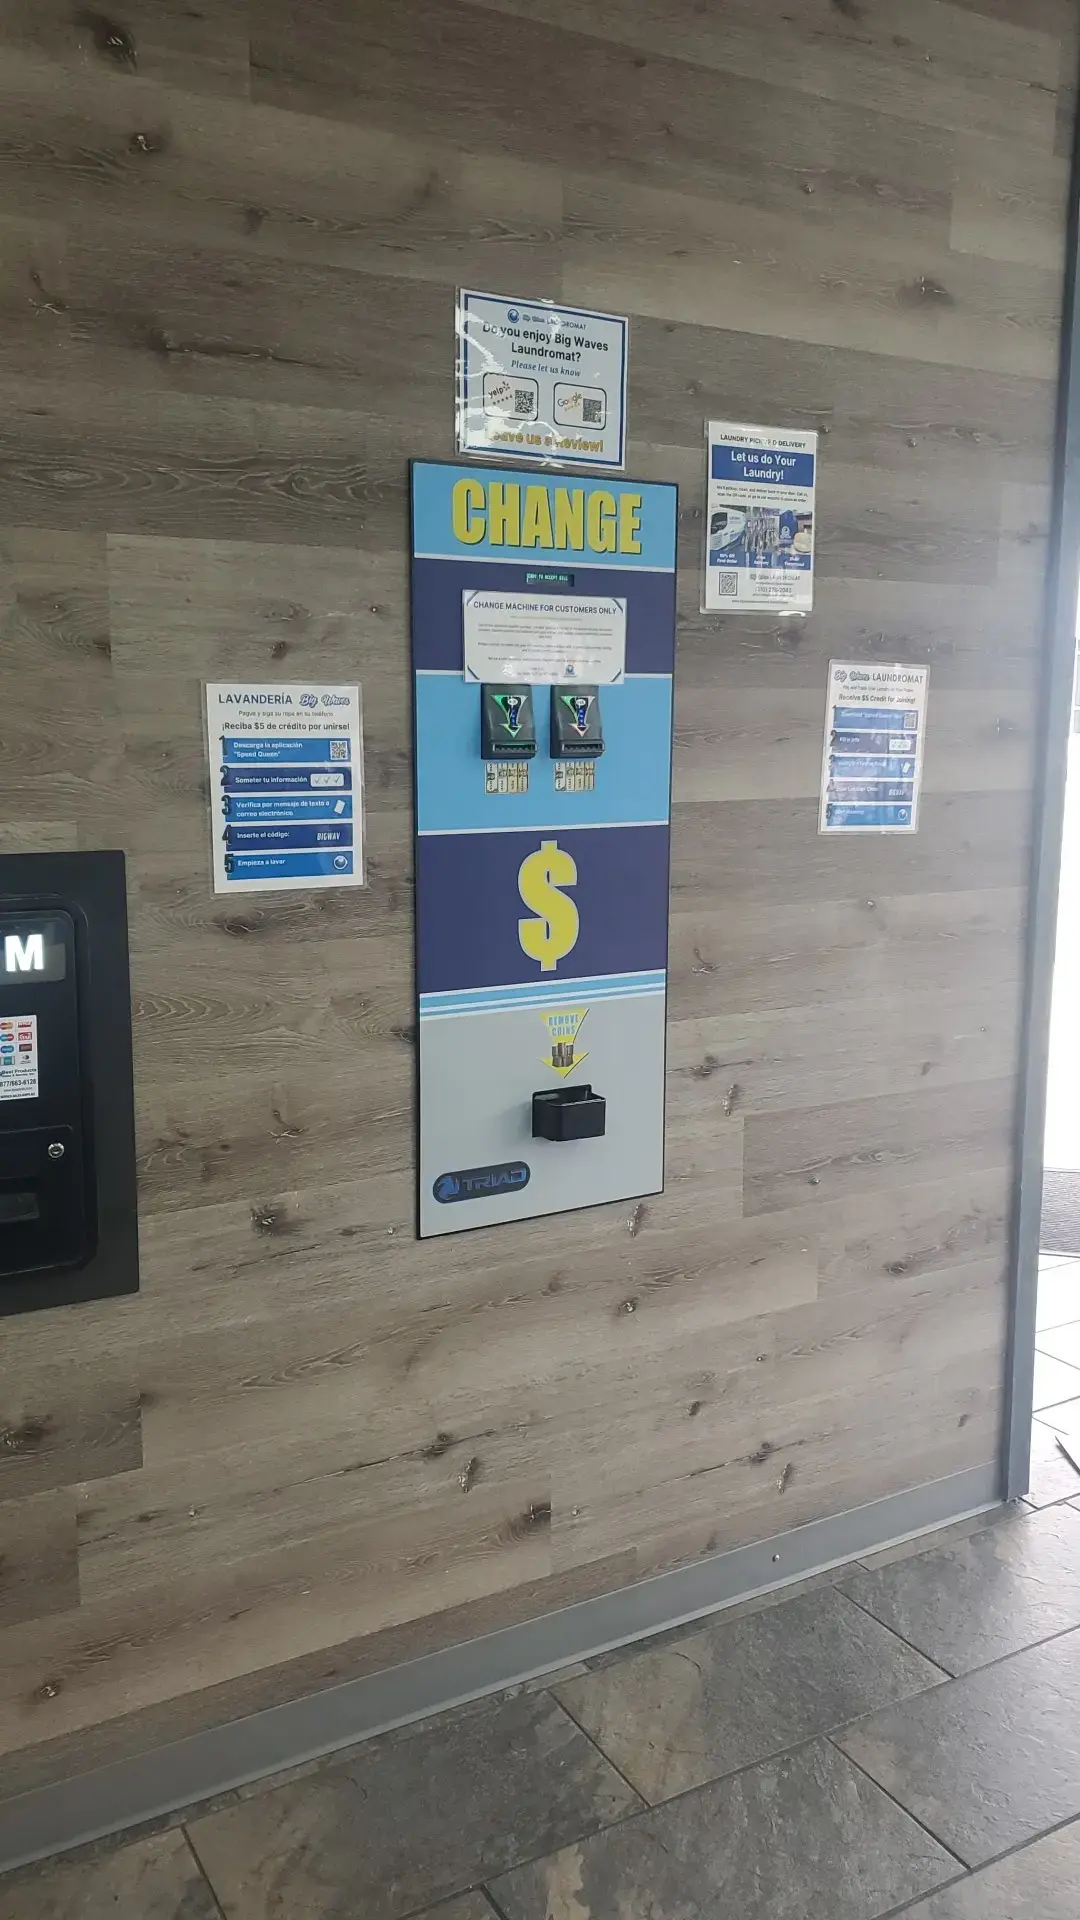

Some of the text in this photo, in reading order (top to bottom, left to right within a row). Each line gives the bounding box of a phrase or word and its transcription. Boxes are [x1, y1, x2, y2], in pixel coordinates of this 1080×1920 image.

[546, 317, 586, 330] LAUDROMAT
[500, 326, 520, 338] you
[523, 328, 551, 344] enjoy
[555, 334, 571, 347] Big
[574, 336, 608, 351] Waves
[511, 342, 581, 362] Laundromat?
[511, 359, 536, 370] Please
[538, 363, 548, 373] let
[561, 367, 581, 377] know
[526, 434, 542, 445] us
[720, 434, 748, 442] LAUNDRY
[731, 450, 796, 466] Let us do Your
[743, 466, 784, 482] Laundry!
[452, 478, 642, 555] CHANGE
[473, 601, 617, 615] CHANGE MACHINE FOR CUSTOMERS ONLY
[872, 673, 923, 684] LAUNDROMAT
[218, 692, 293, 705] LAVANDERÍA
[839, 693, 861, 701] Receive
[238, 710, 256, 718] Pague
[262, 710, 273, 718] siga
[222, 721, 350, 732] ¡Reciba $5 de crédito por unirse!
[219, 765, 232, 786] 2
[235, 776, 262, 784] Someter
[221, 794, 232, 816] 3
[267, 831, 290, 839] código:
[224, 854, 235, 874] 5
[518, 840, 580, 972] $
[4, 933, 45, 972] M
[548, 1013, 579, 1027] REMOVE
[552, 1025, 576, 1037] COINS
[462, 1167, 527, 1191] TRIAD
